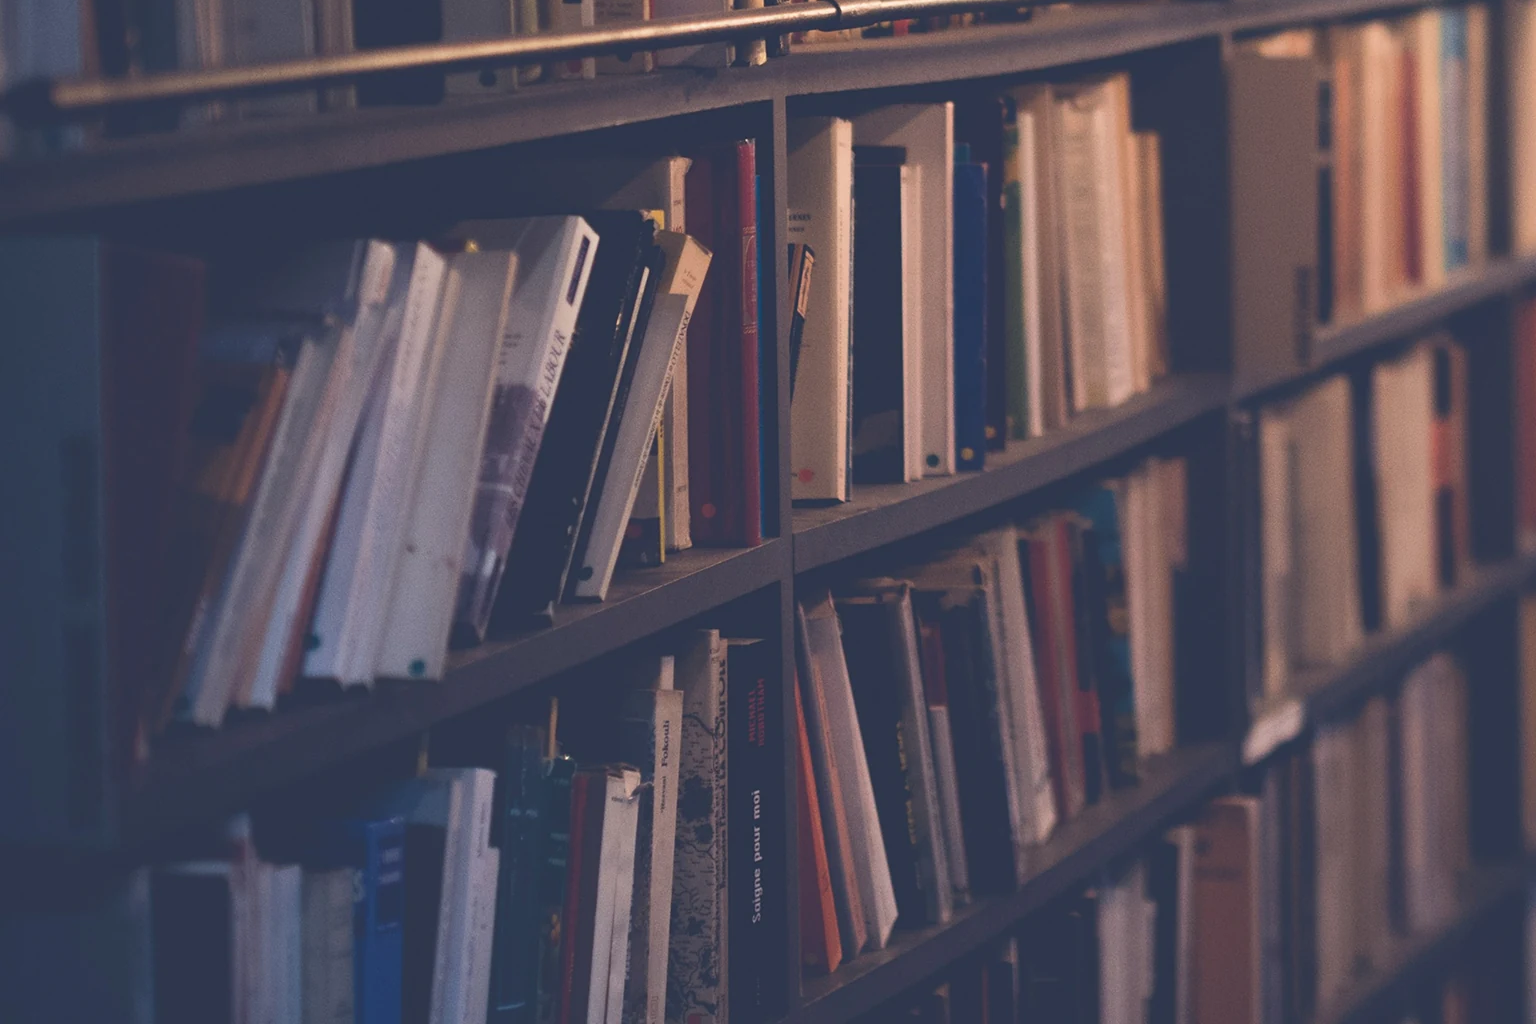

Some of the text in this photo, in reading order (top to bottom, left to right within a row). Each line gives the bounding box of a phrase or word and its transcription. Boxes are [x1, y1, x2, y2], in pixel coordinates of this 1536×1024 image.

[537, 328, 567, 396] LABOUR
[667, 310, 694, 365] DONATELLO
[748, 688, 756, 742] MICHAEL
[750, 789, 763, 923] Saigne pour moi
